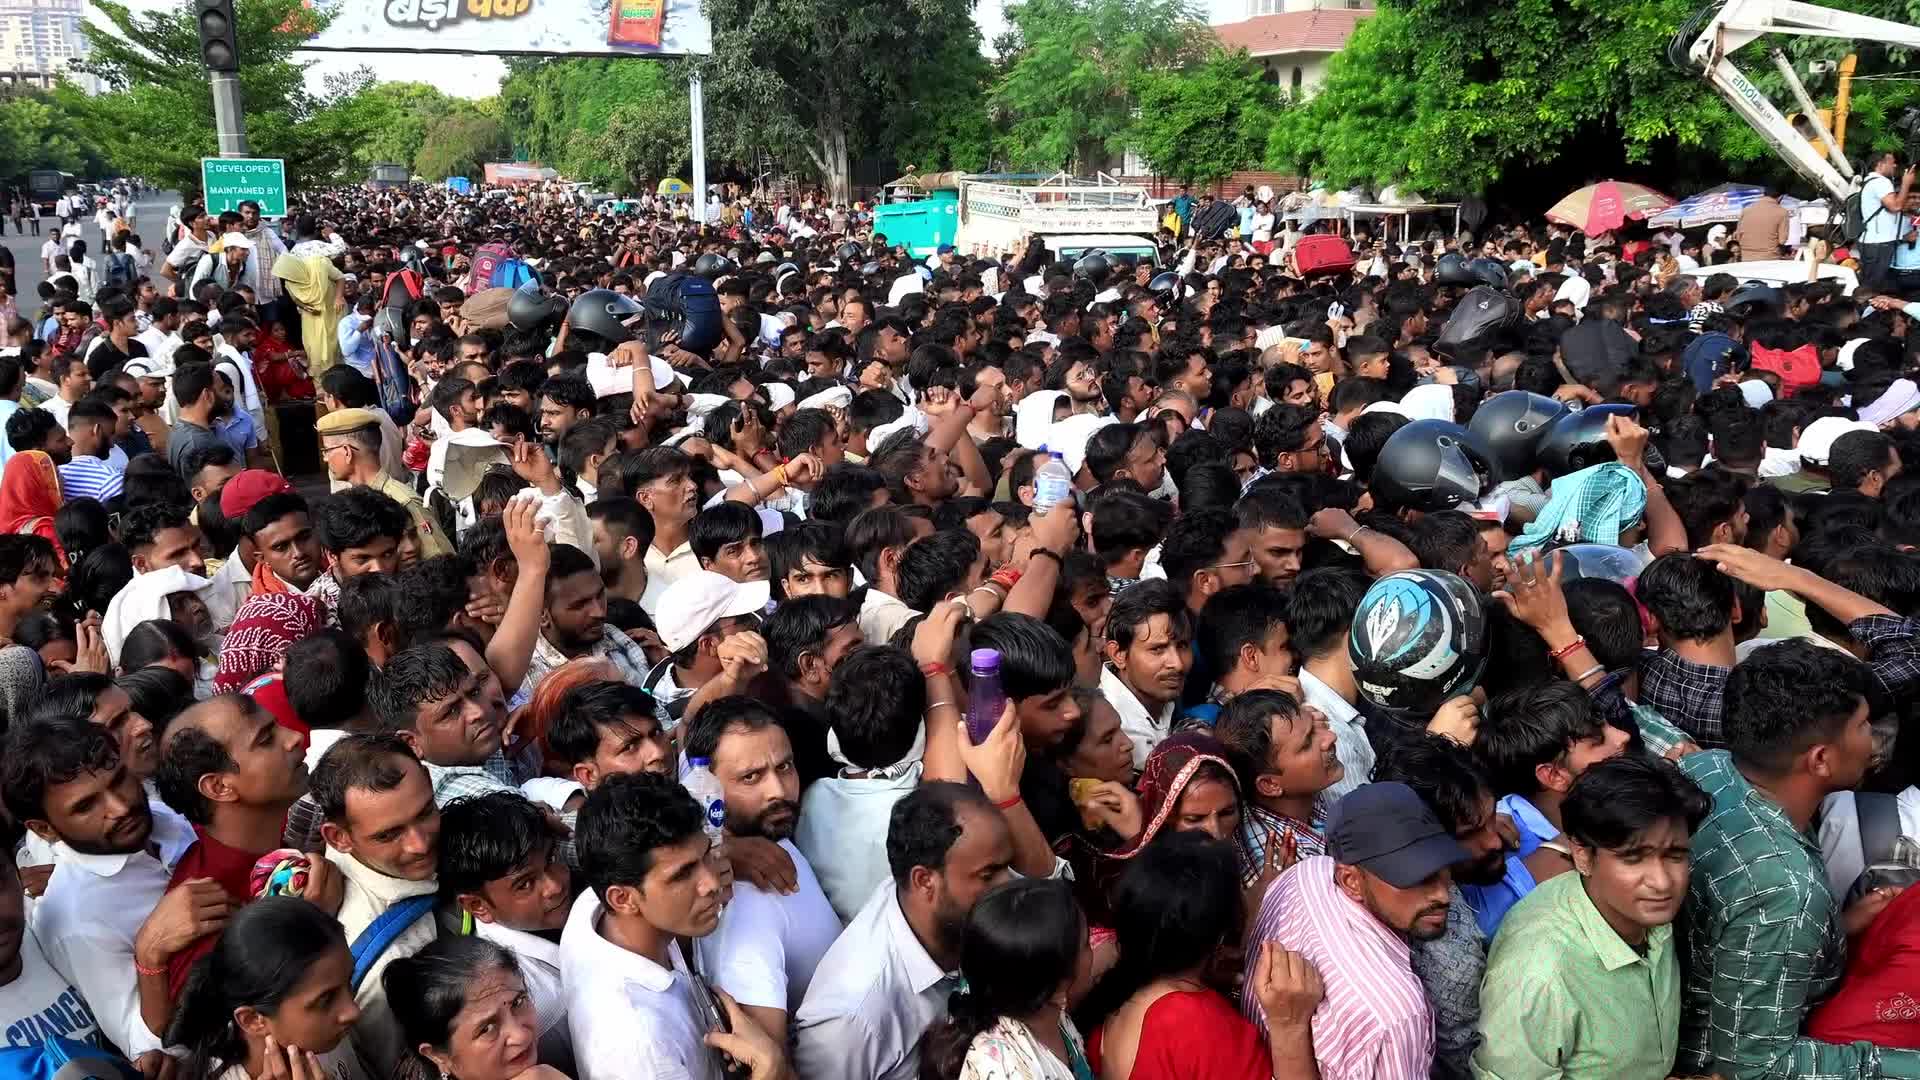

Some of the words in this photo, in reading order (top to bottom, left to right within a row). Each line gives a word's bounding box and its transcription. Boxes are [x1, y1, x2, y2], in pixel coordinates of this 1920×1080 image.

[215, 164, 270, 173] DEVELOPED
[240, 176, 247, 184] &
[209, 187, 264, 195] MAINTAINED
[267, 187, 280, 195] BY
[6, 985, 97, 1046] CHANG
